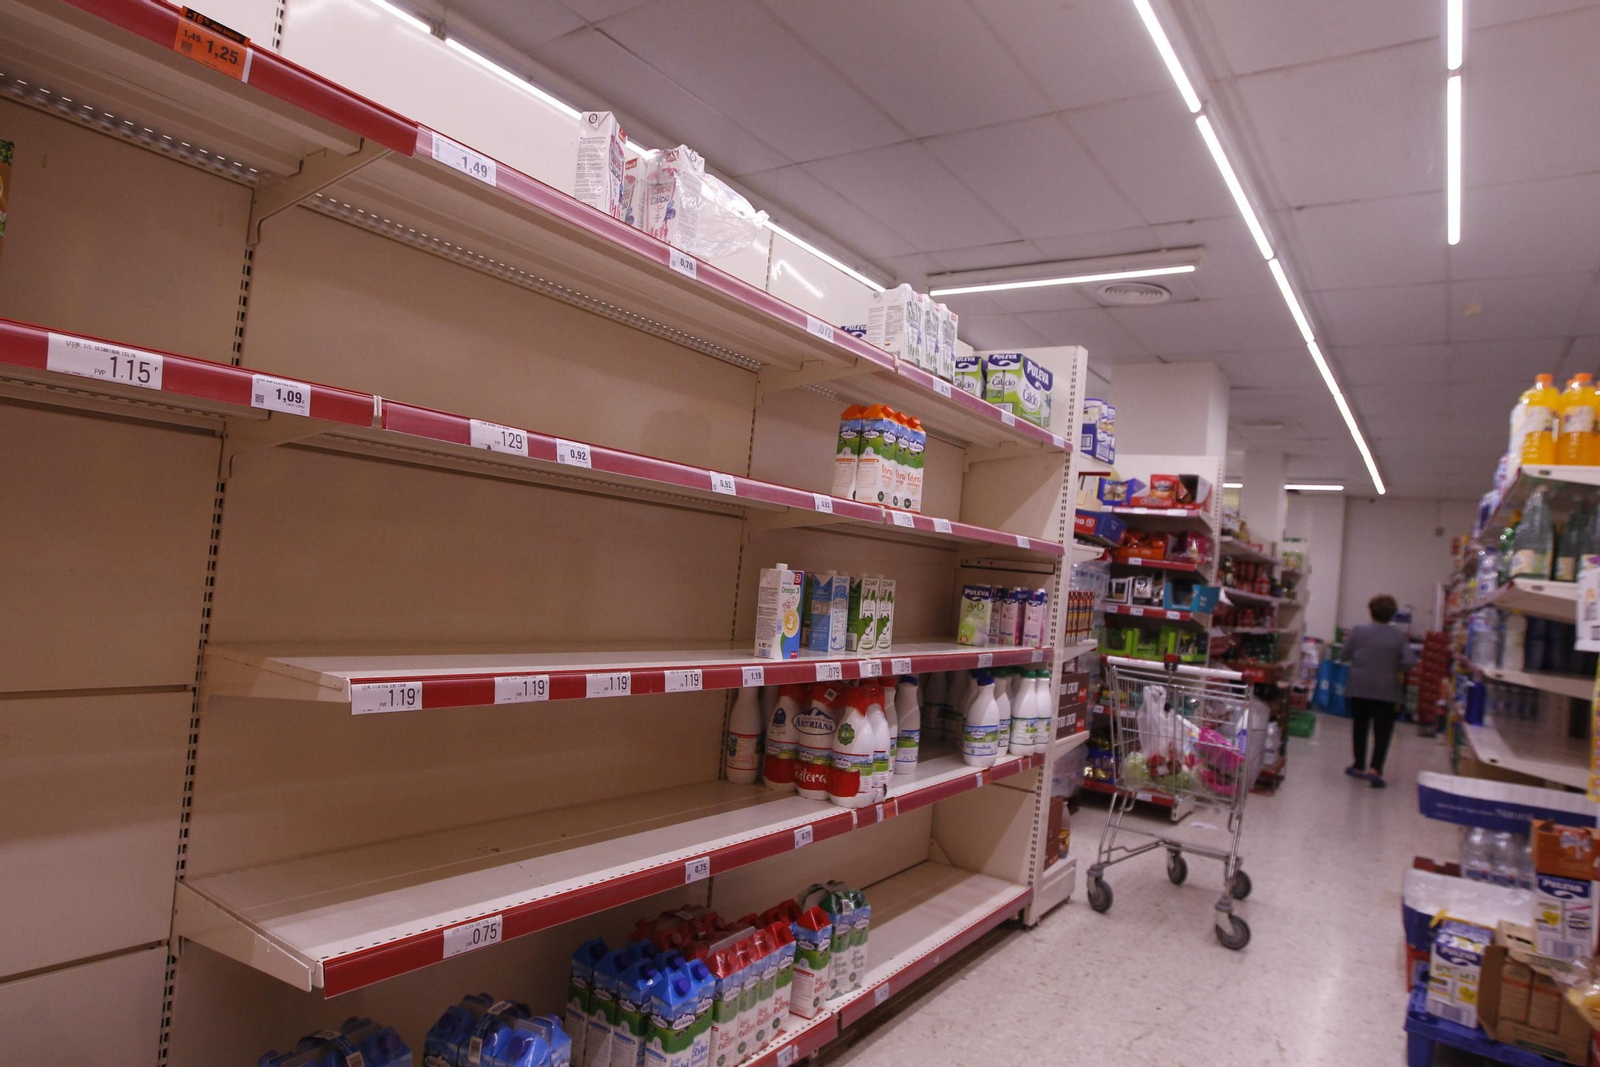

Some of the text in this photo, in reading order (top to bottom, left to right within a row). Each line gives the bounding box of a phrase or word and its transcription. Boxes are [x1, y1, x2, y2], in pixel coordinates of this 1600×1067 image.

[183, 29, 201, 43] 1,49
[206, 40, 239, 65] 1,25
[462, 156, 488, 178] 1,49
[94, 368, 107, 376] PVP
[1027, 360, 1050, 386] PULEVA
[570, 449, 586, 460] 0,92
[720, 479, 732, 489] 0,92
[782, 587, 796, 595] Omega
[964, 588, 990, 596] PULEVA
[694, 863, 708, 874] 0,75
